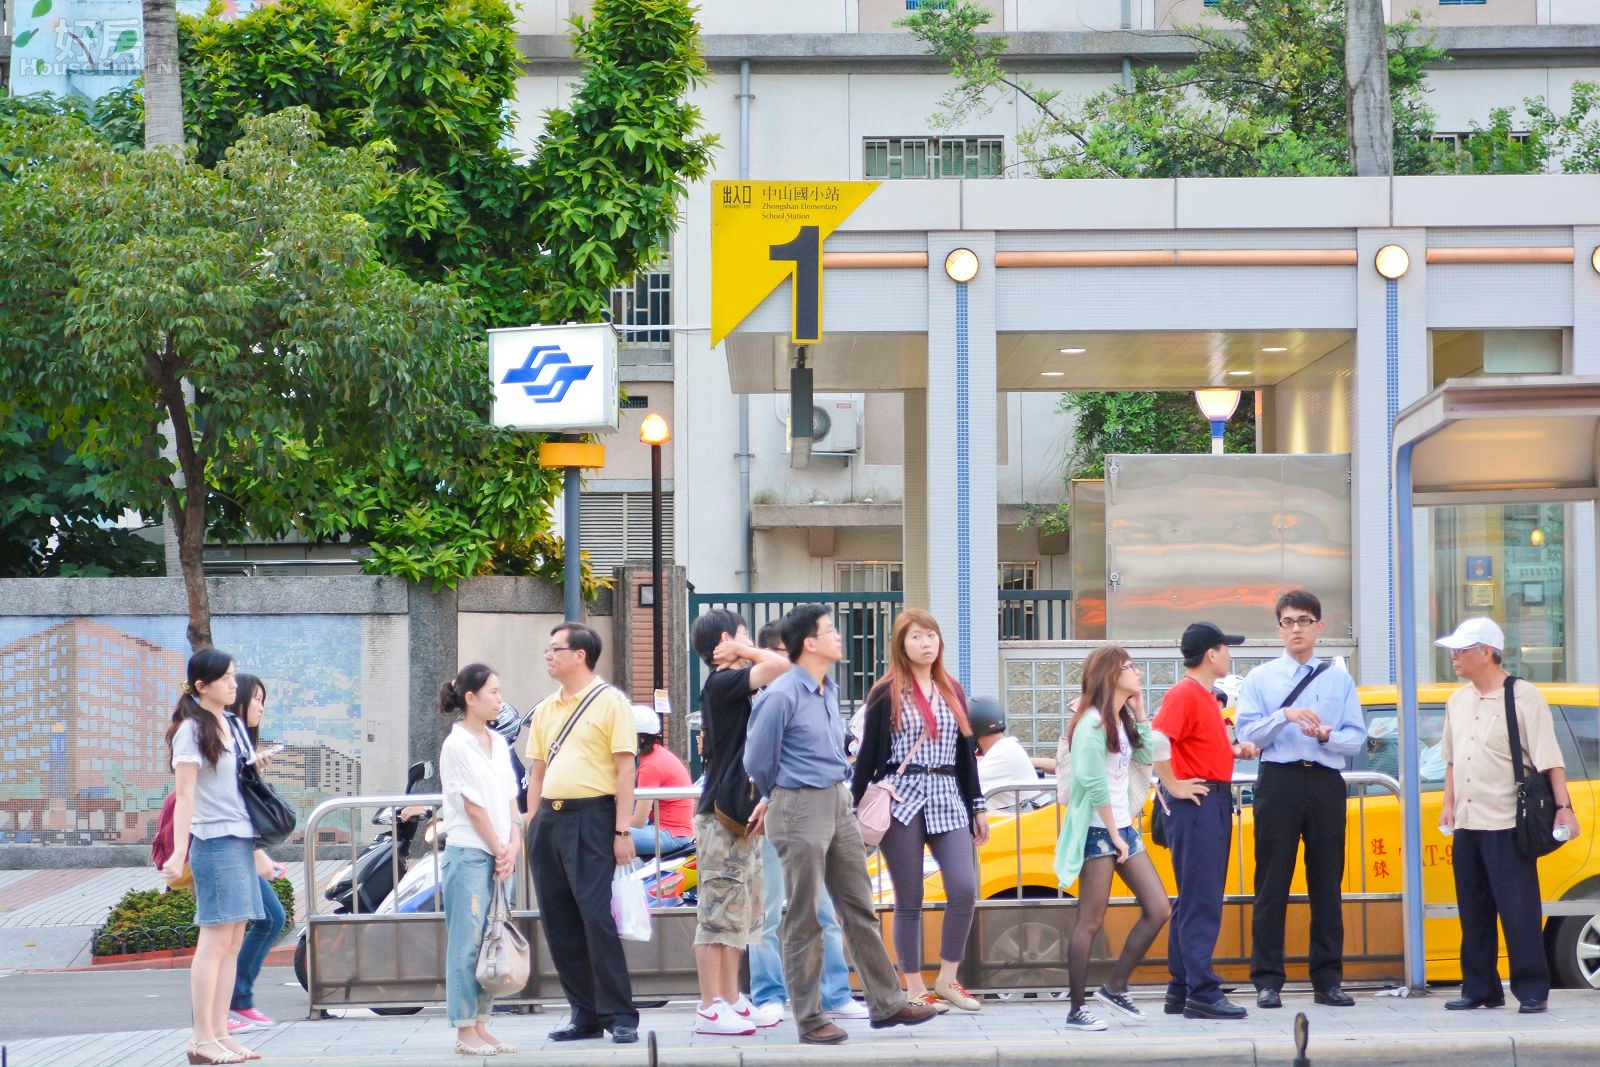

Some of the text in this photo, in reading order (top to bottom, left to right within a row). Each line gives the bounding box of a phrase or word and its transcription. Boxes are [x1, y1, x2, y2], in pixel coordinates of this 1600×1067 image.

[722, 185, 752, 204] 出入口
[762, 185, 840, 202] 中山國小站
[761, 202, 799, 212] Zhongshan
[800, 202, 838, 212] Elementary
[761, 212, 810, 220] School Station
[769, 226, 820, 340] 1
